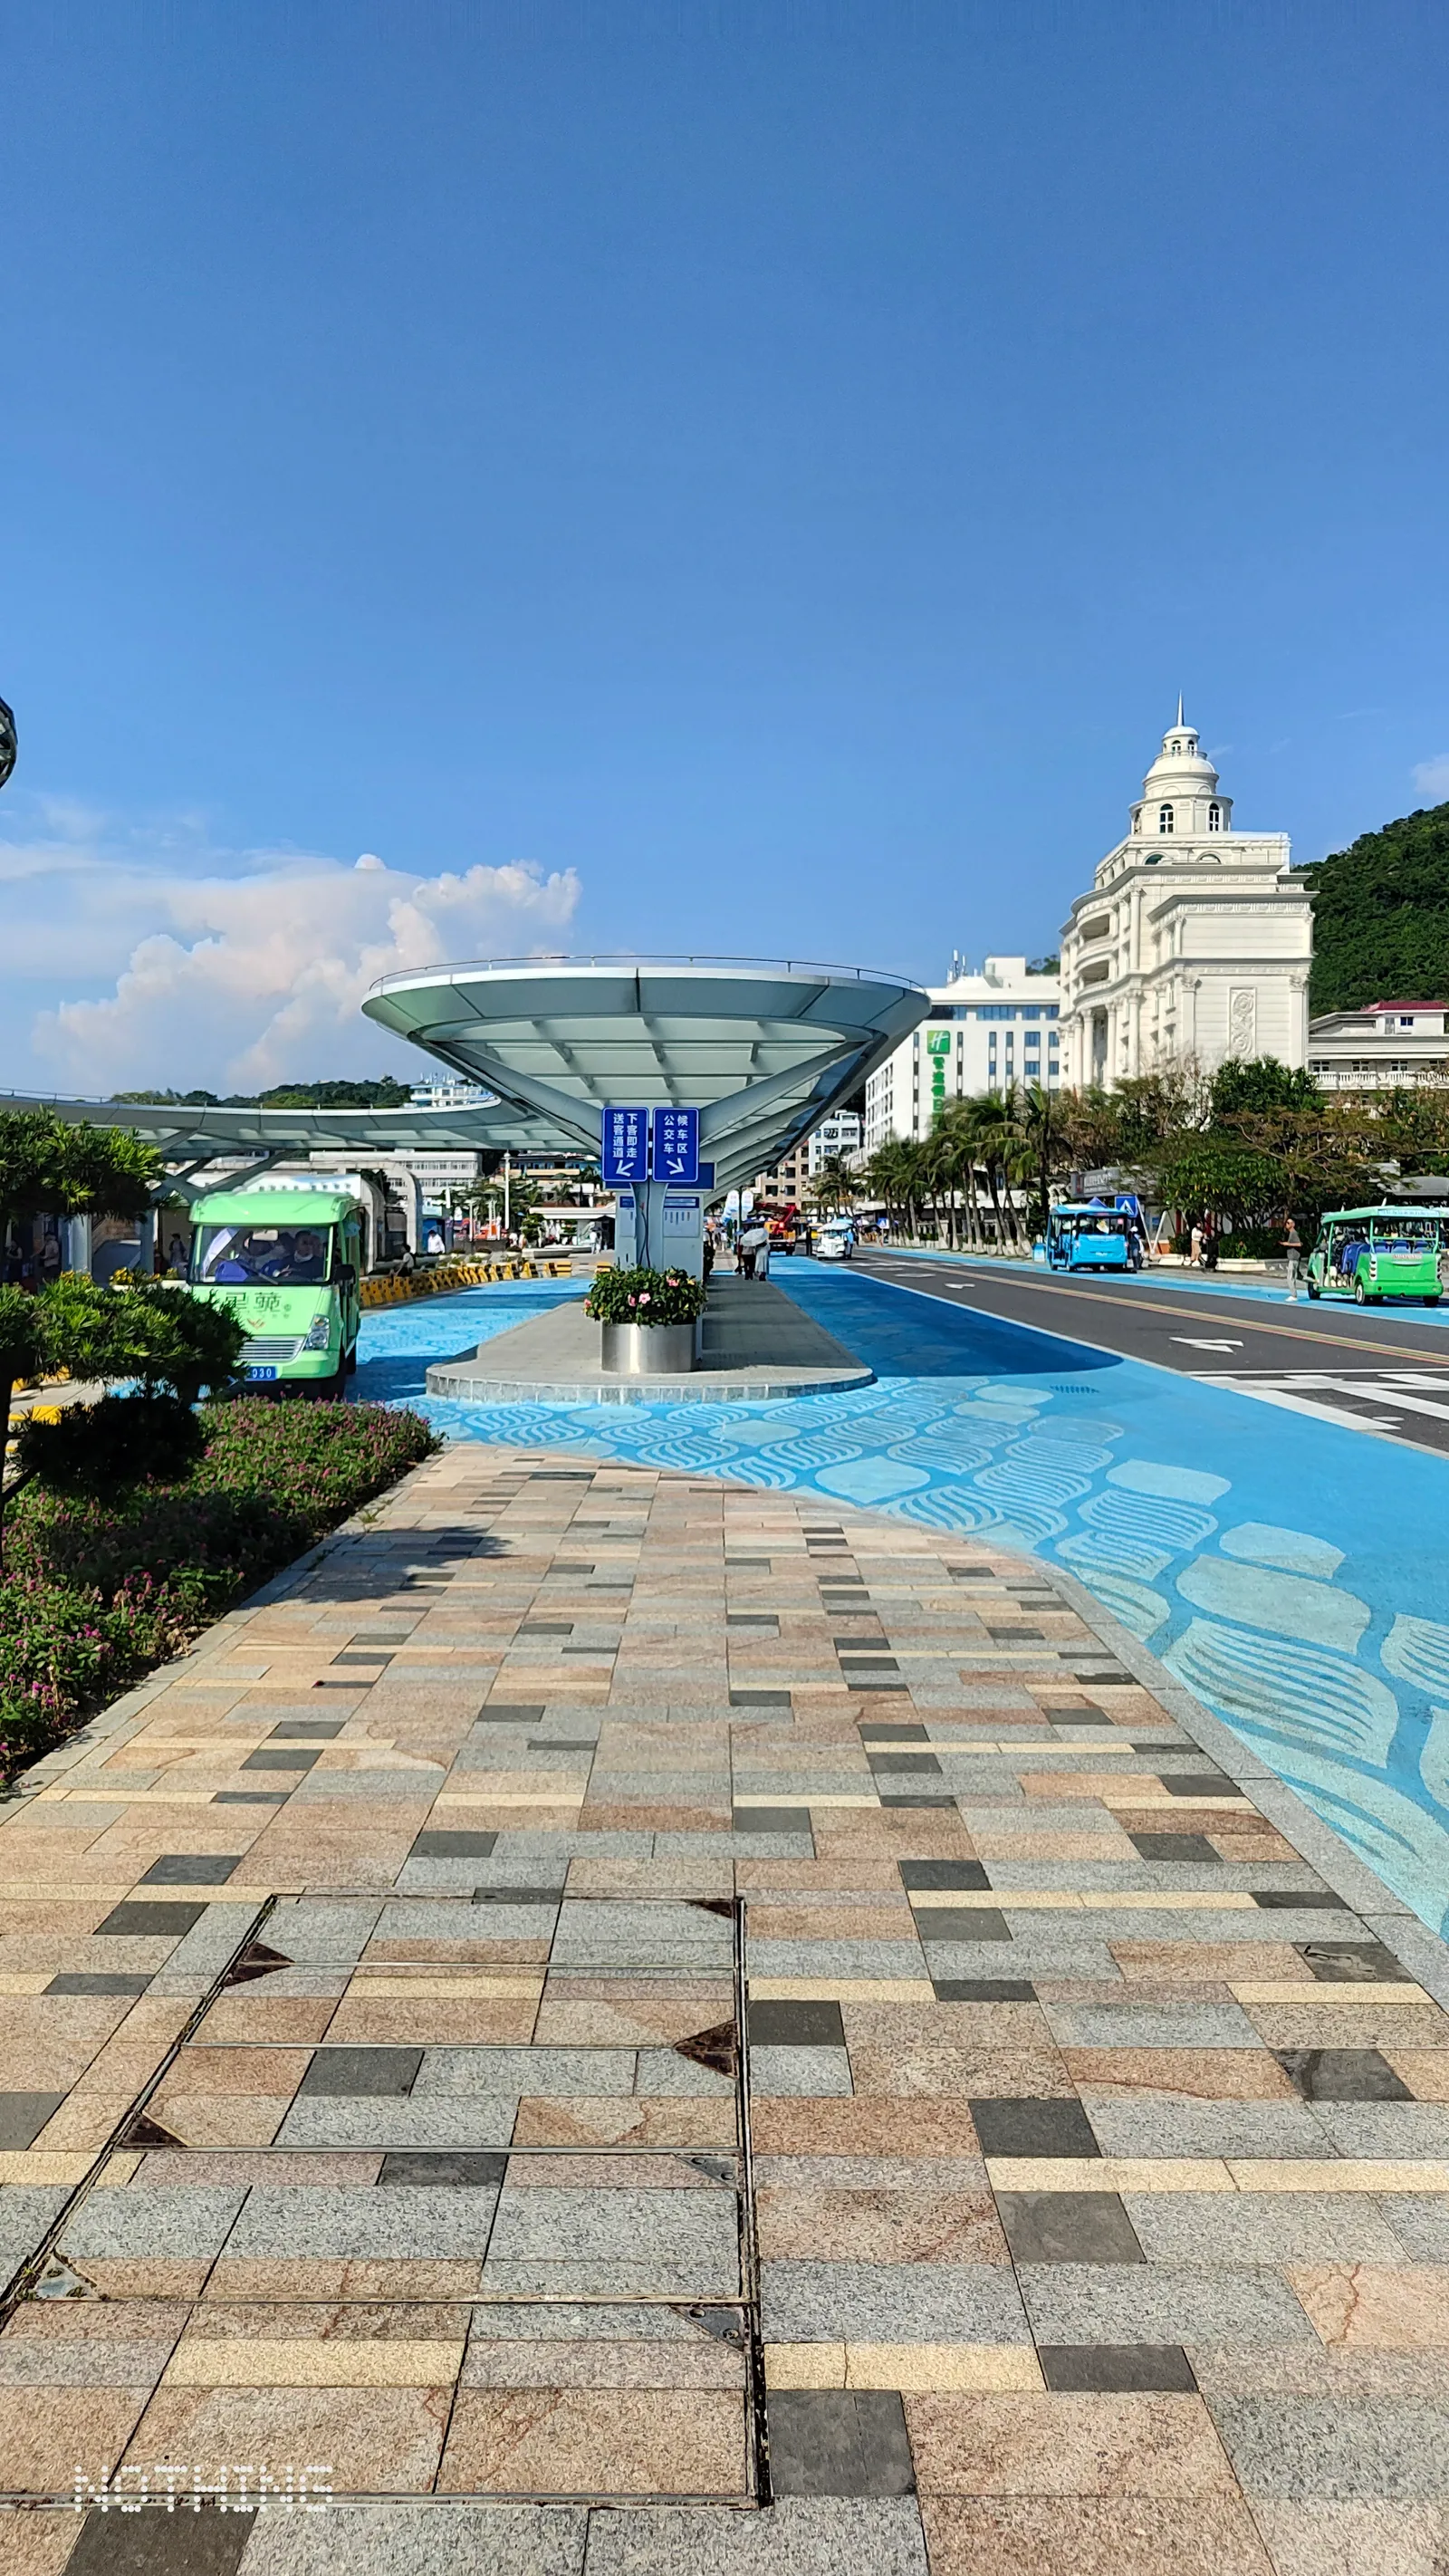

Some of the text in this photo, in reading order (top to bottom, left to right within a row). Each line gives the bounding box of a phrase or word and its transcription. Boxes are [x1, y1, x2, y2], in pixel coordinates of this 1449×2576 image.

[613, 1113, 624, 1158] 送客通道
[627, 1113, 638, 1158] 下客即走
[664, 1115, 675, 1154] 公交车
[677, 1115, 688, 1154] 候车区
